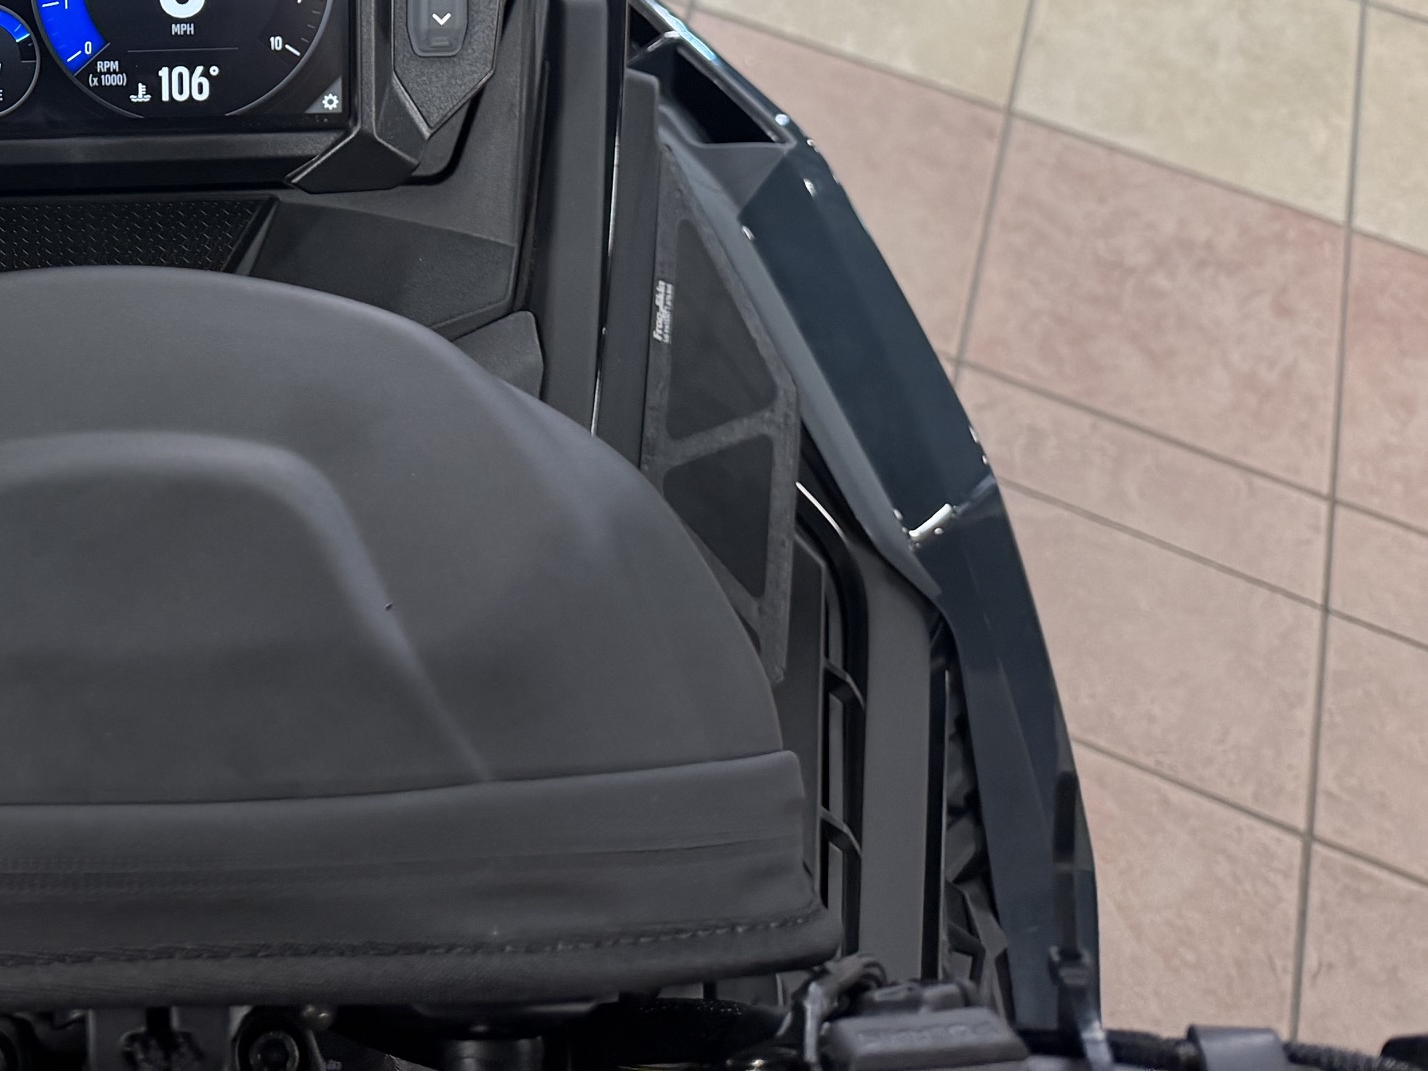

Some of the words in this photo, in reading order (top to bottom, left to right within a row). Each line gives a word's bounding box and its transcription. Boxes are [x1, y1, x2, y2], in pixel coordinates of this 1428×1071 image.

[171, 23, 195, 36] MPH
[84, 41, 93, 55] 0
[269, 36, 283, 51] 10
[96, 61, 119, 73] RPM
[88, 74, 99, 87] (x
[101, 74, 127, 86] 1000)
[158, 65, 220, 102] 106°
